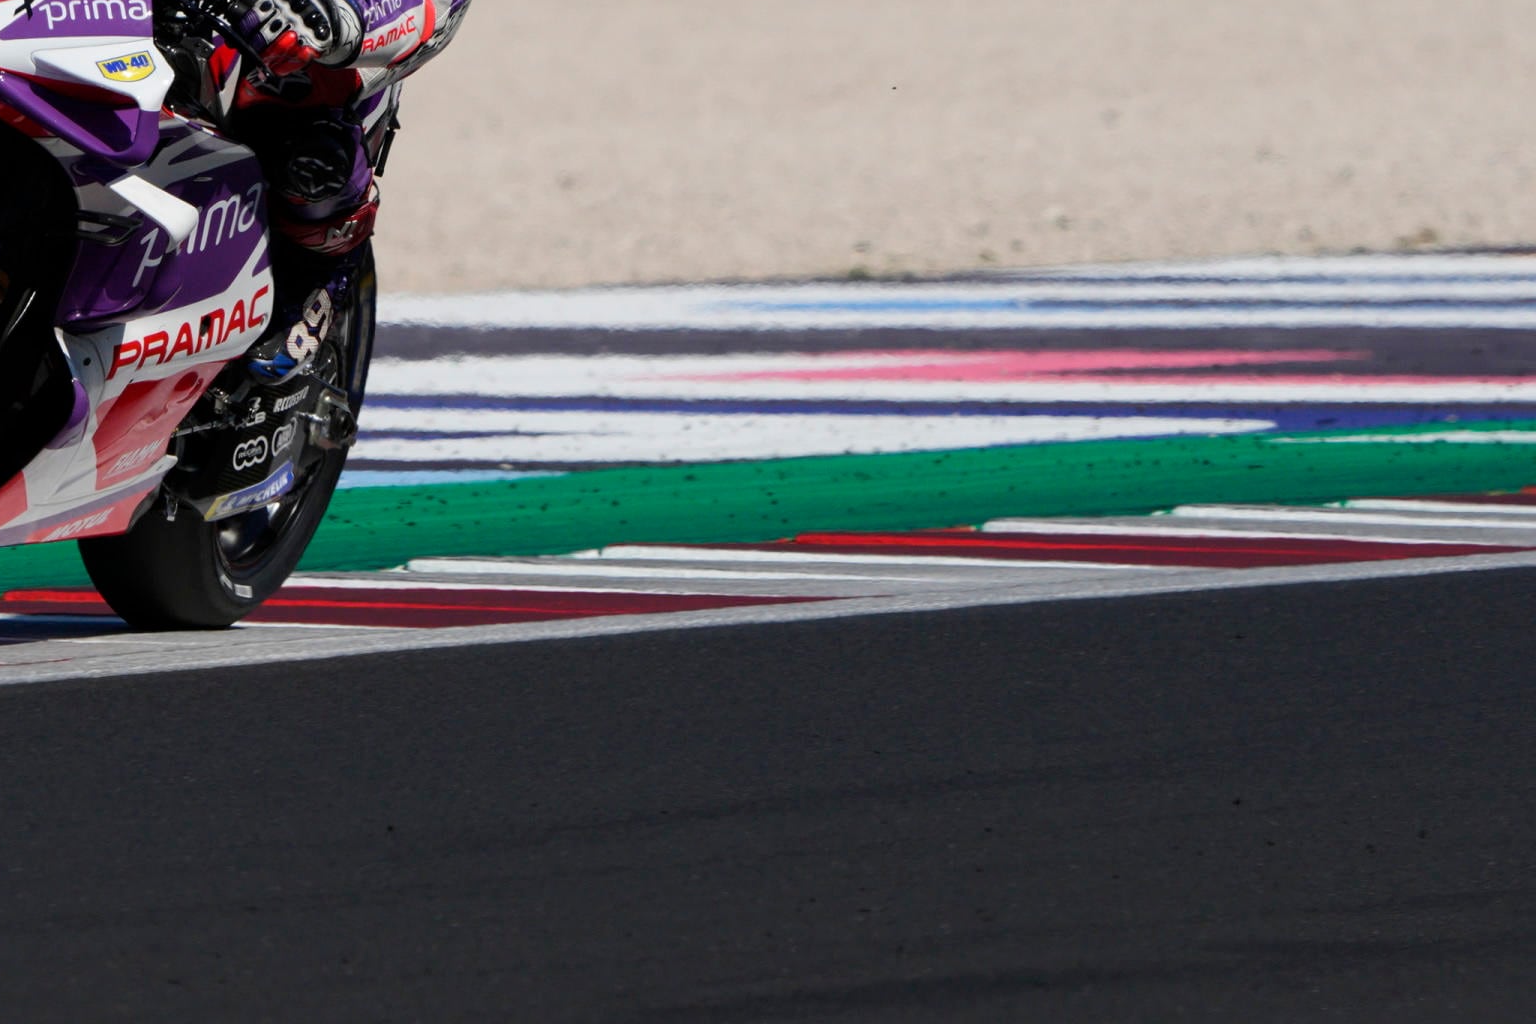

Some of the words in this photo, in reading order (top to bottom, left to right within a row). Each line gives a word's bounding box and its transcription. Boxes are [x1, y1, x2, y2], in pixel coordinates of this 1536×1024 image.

[102, 54, 149, 74] WD-40
[361, 15, 417, 55] RAMAC
[132, 182, 263, 288] pima
[106, 284, 269, 380] PRAMAC
